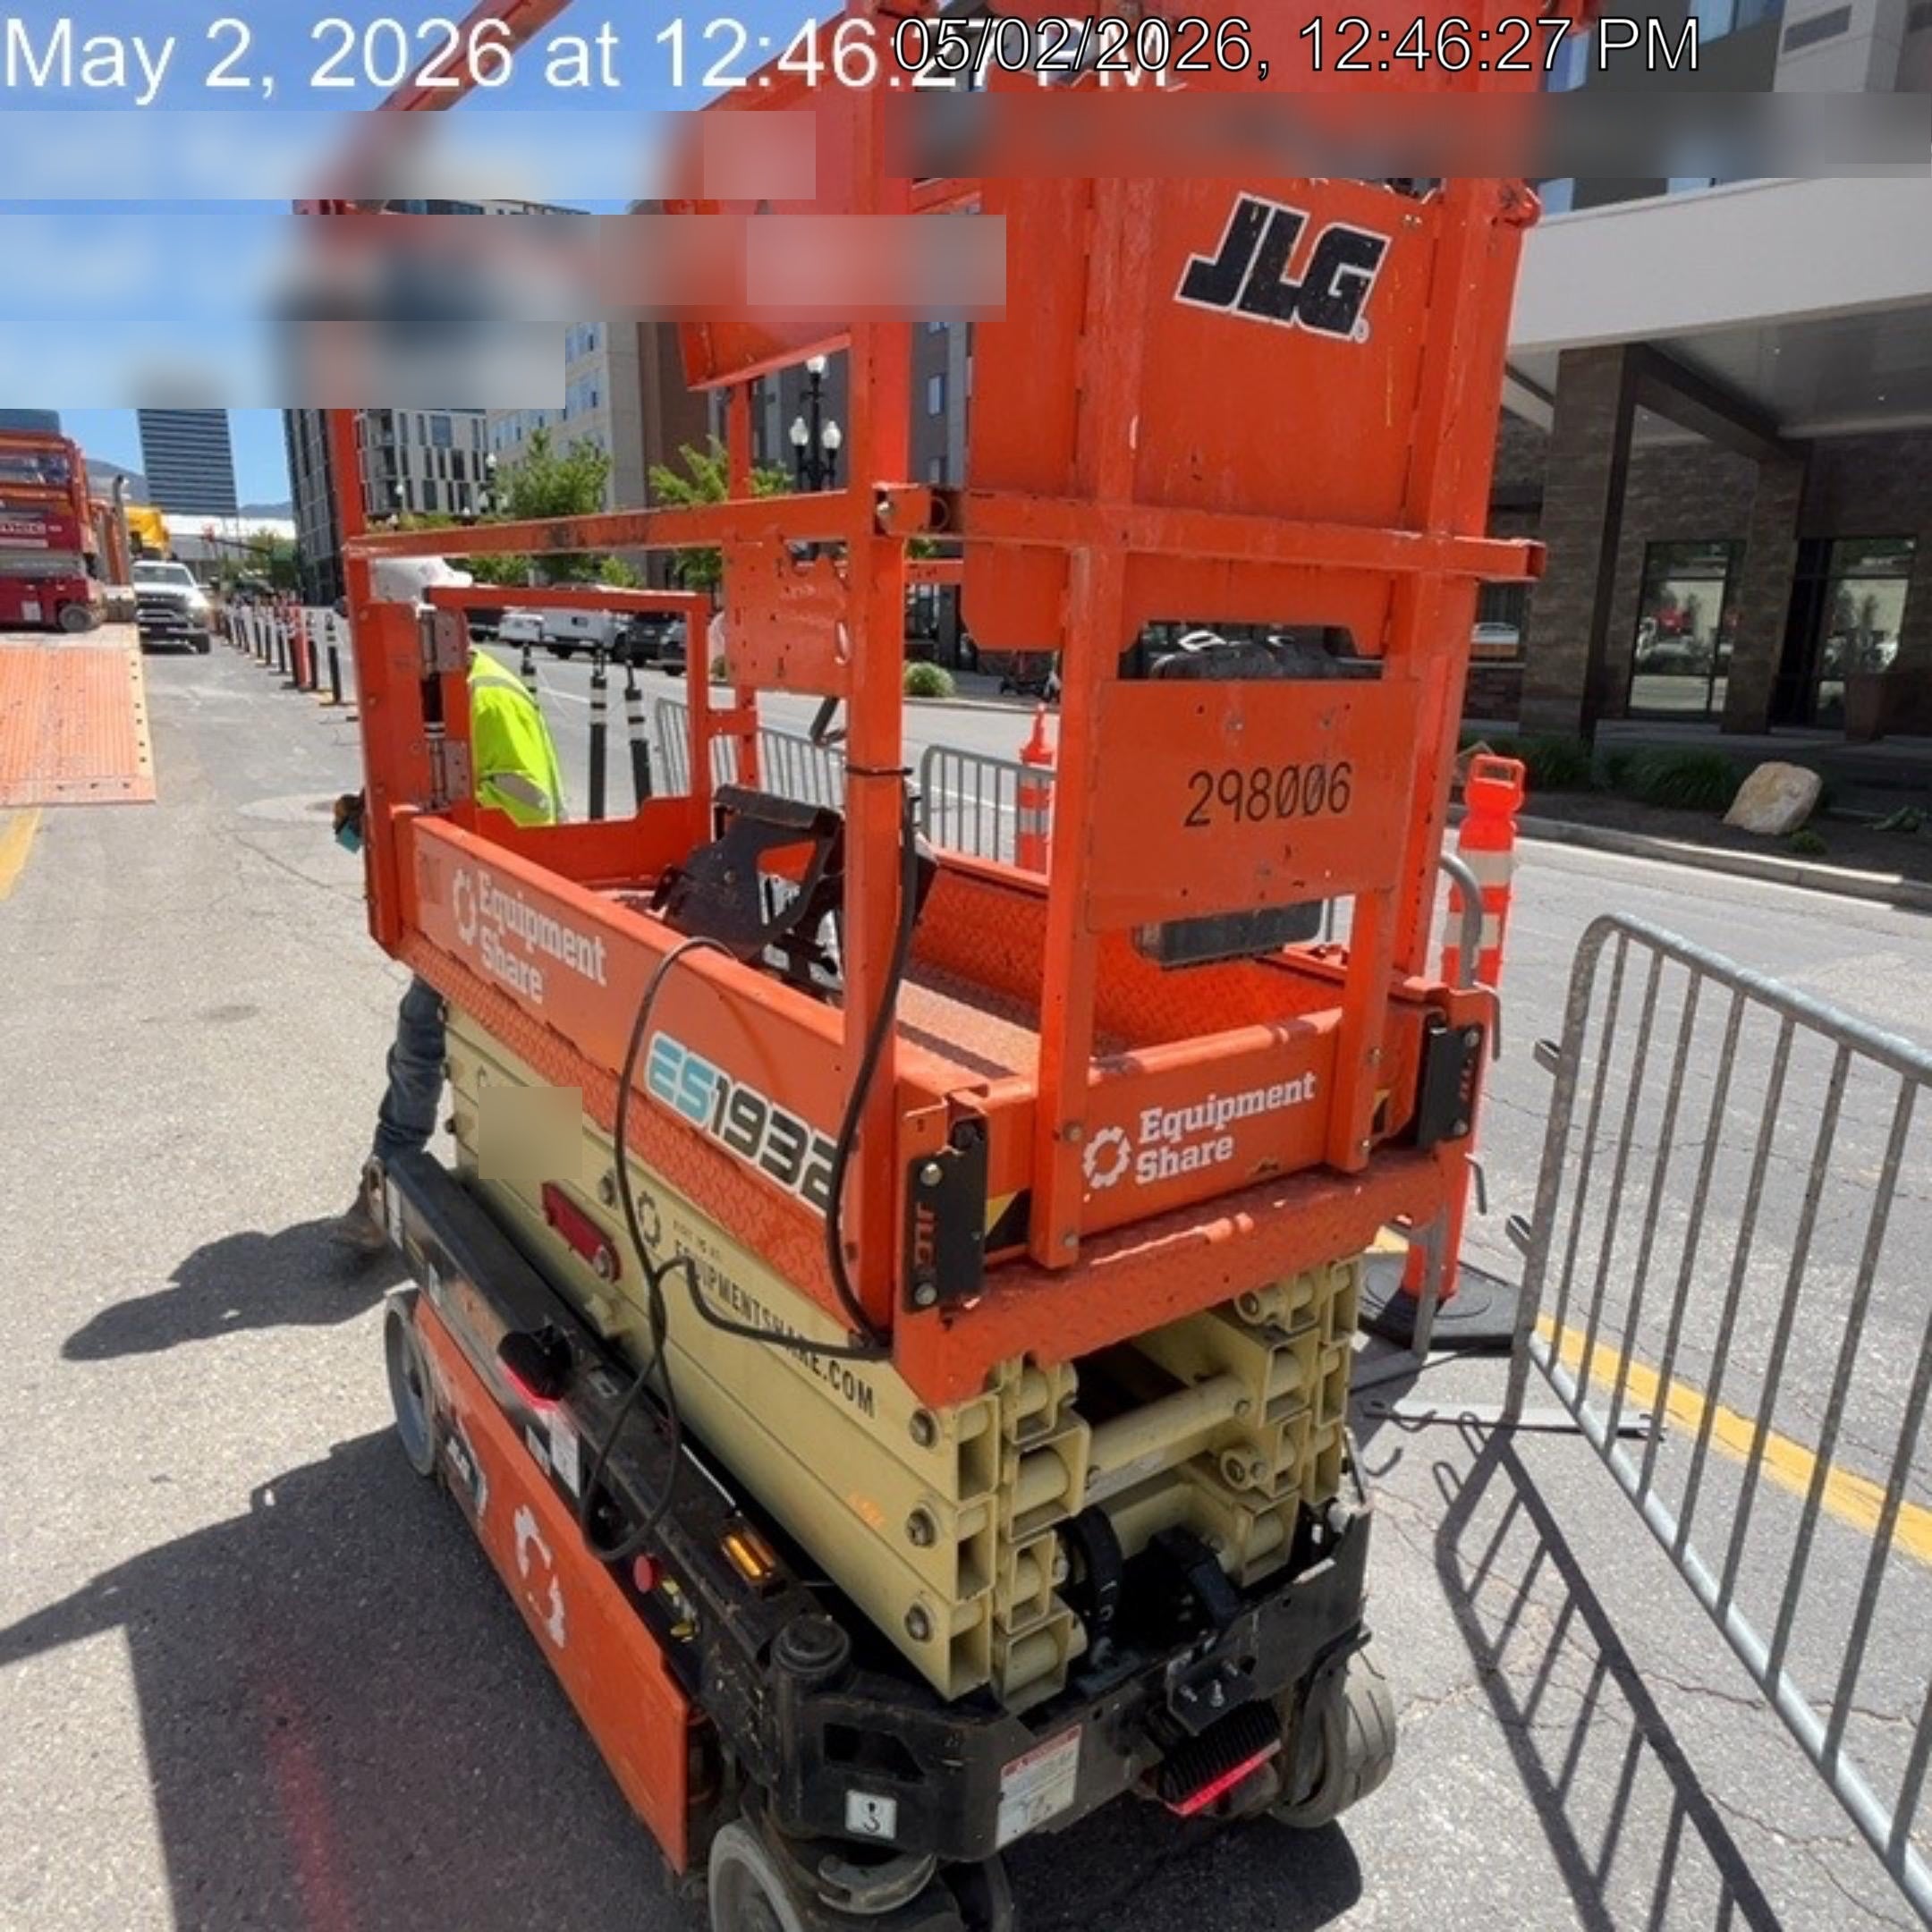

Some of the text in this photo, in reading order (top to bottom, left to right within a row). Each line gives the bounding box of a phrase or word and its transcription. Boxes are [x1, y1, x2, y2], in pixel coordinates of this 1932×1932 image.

[1174, 191, 1393, 342] JLG
[1182, 761, 1353, 828] 298006
[477, 868, 608, 987] Equipment
[479, 924, 544, 1005] Share
[1139, 1071, 1317, 1145] Equipment
[1135, 1135, 1234, 1186] Share
